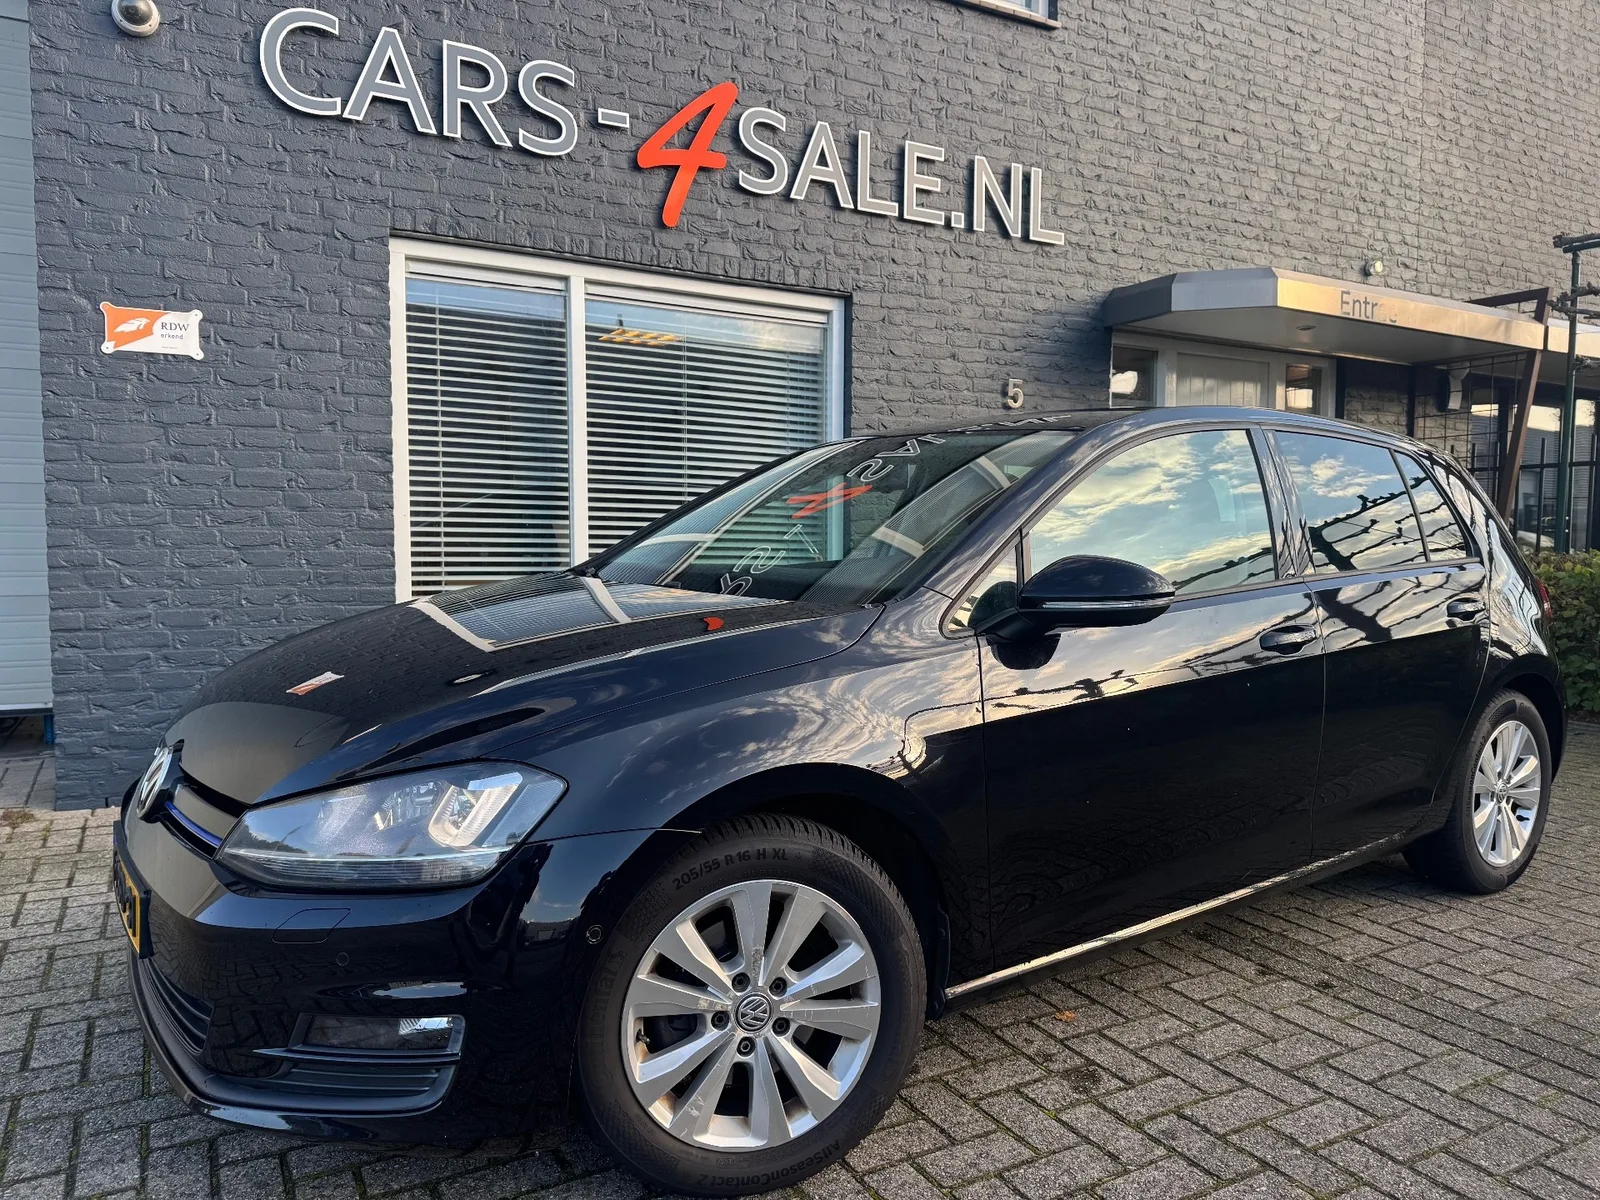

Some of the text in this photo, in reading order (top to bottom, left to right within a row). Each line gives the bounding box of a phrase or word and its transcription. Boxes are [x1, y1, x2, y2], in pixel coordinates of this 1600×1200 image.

[160, 321, 190, 333] RDW
[160, 332, 184, 341] erkend
[1007, 378, 1024, 409] 5
[672, 848, 788, 890] 205/55 R 16 H XL
[710, 1139, 841, 1187] AllSeasonContact
